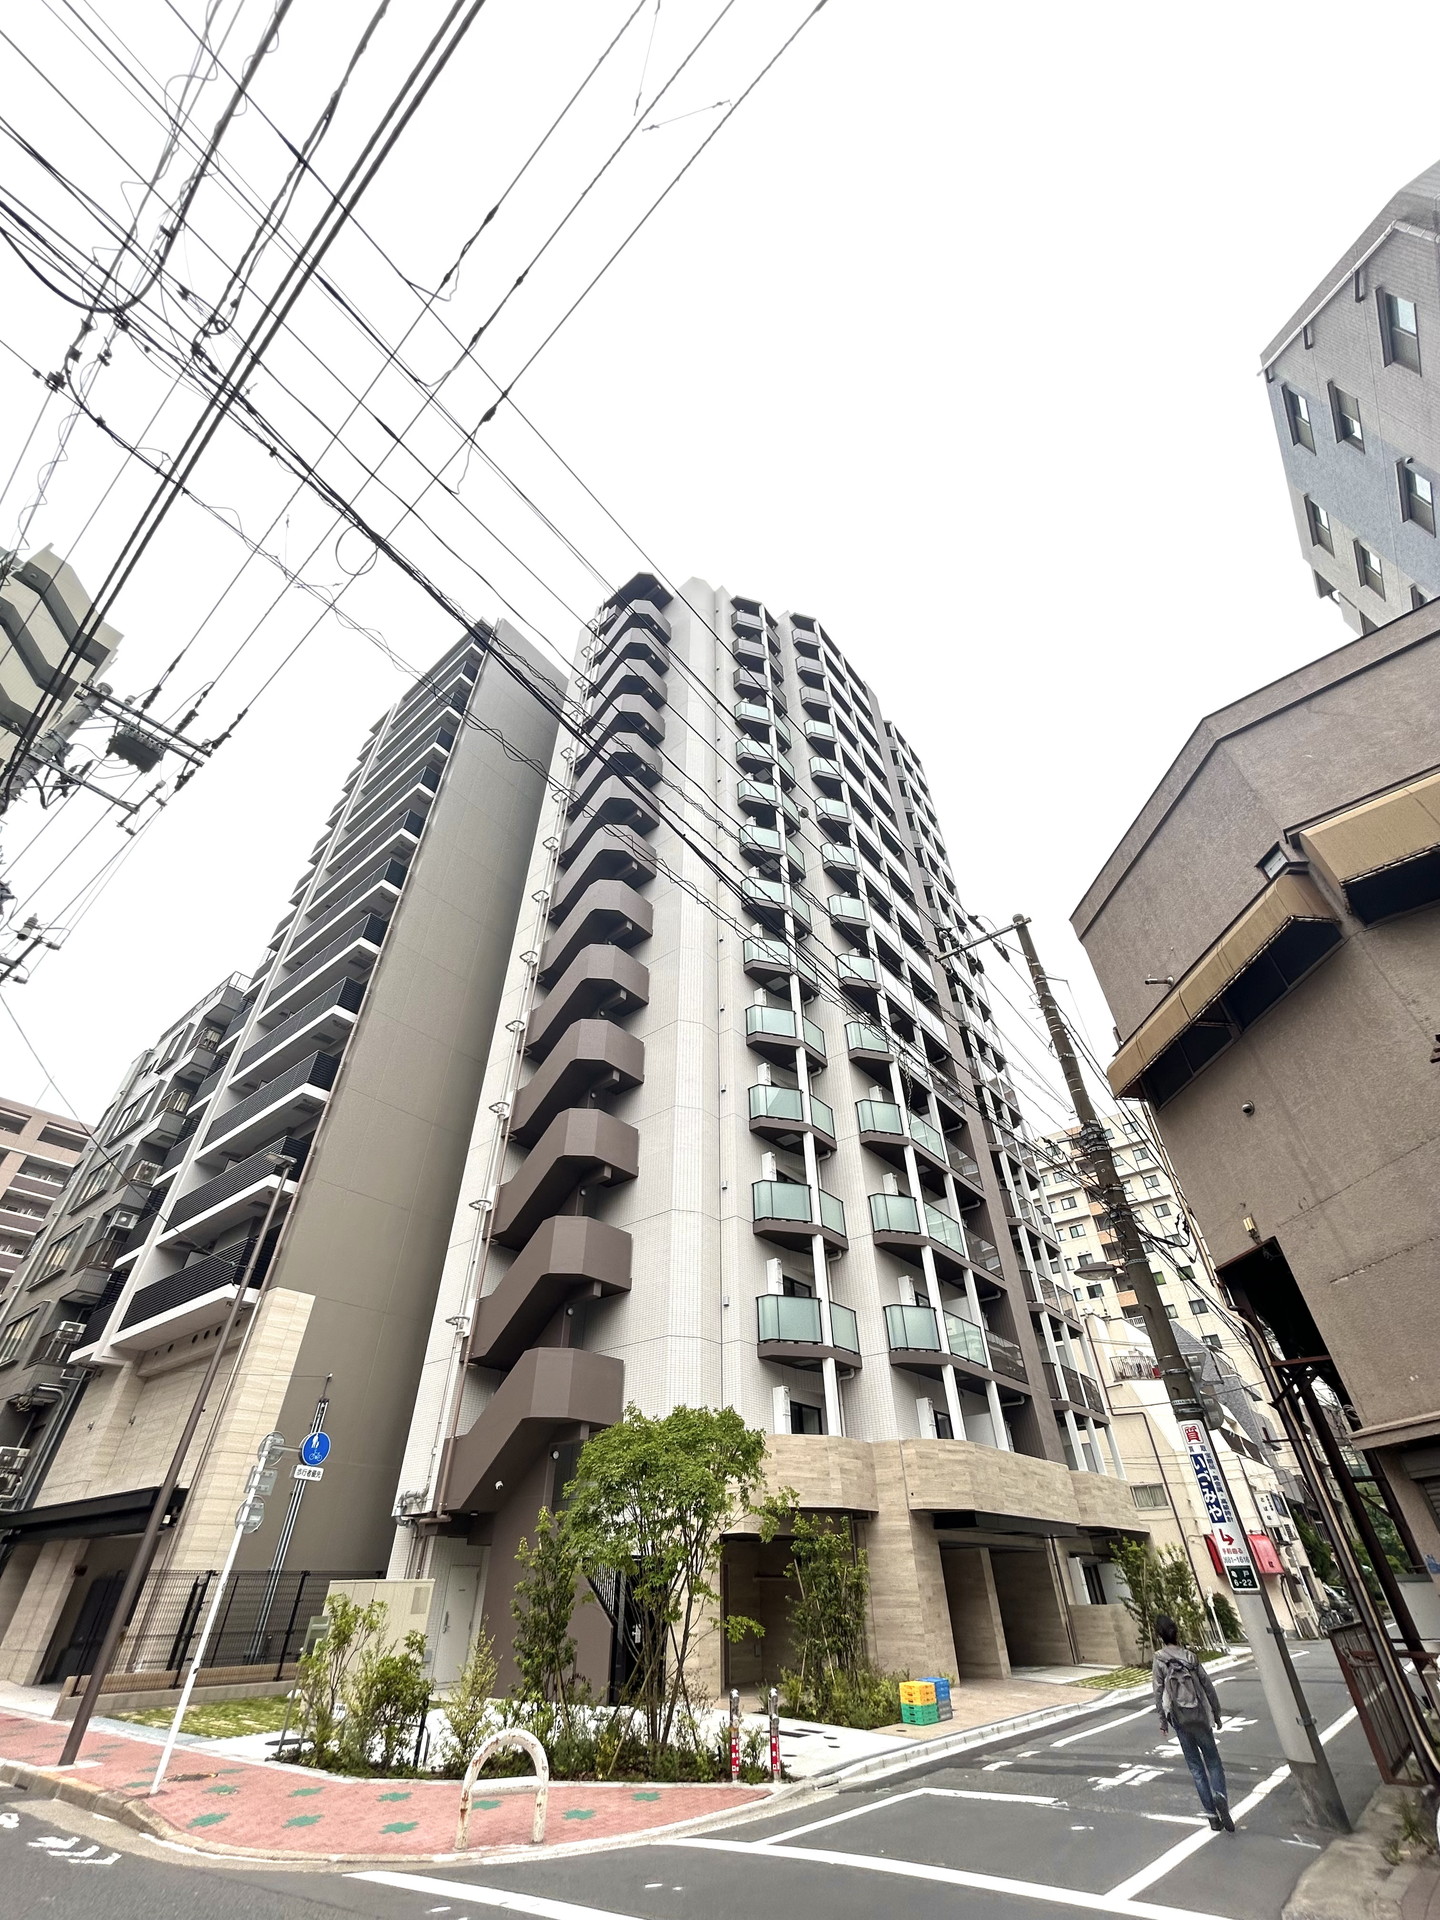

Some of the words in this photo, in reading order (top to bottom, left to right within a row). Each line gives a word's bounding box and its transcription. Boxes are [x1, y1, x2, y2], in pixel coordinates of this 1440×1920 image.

[1184, 1426, 1201, 1442] 質
[296, 1469, 322, 1478] 歩行者優先
[1191, 1456, 1222, 1521] いづみや
[1233, 1579, 1253, 1587] 6-22
